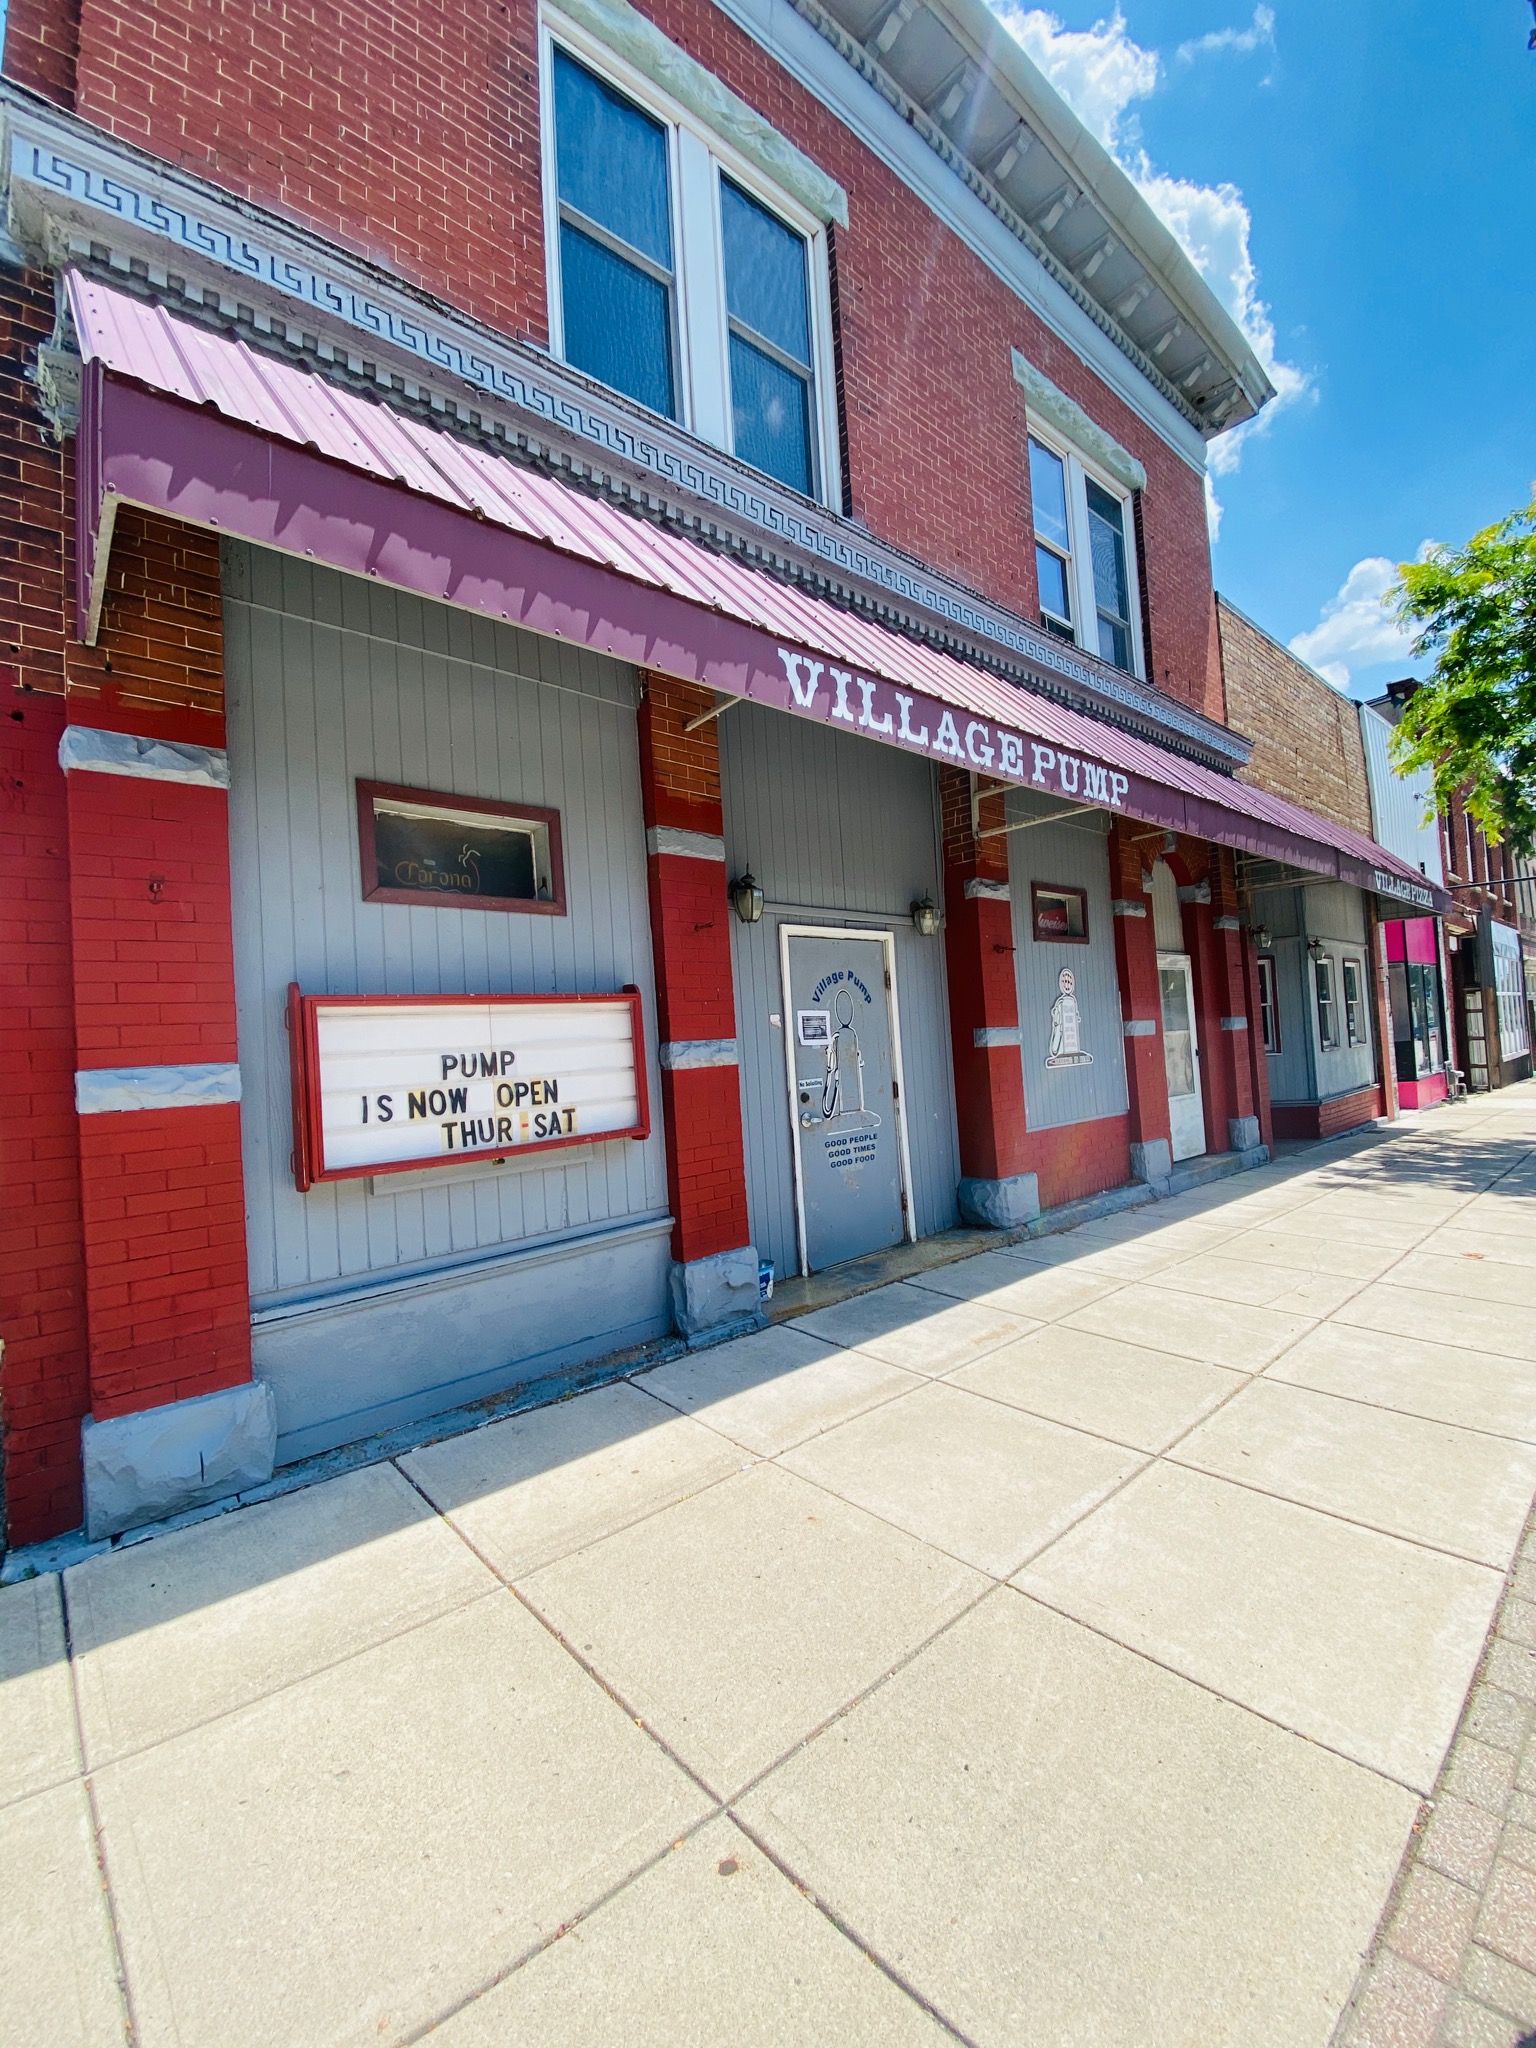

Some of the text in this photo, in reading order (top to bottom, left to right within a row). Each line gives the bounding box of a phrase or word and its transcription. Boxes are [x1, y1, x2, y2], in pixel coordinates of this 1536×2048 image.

[777, 647, 1129, 806] VILLAGE PUMP
[395, 861, 472, 888] Corona
[1375, 870, 1434, 908] VILLAGE PIZZA
[812, 969, 872, 1004] Village Pump
[441, 1050, 515, 1080] PUMP
[362, 1079, 558, 1123] IS NOW OPEN
[441, 1117, 513, 1149] THUR
[534, 1108, 576, 1138] SAT
[824, 1132, 878, 1149] GOOD PEOPLE
[828, 1143, 876, 1158] GOOD TIMES
[830, 1153, 876, 1169] GOOD FOOD
